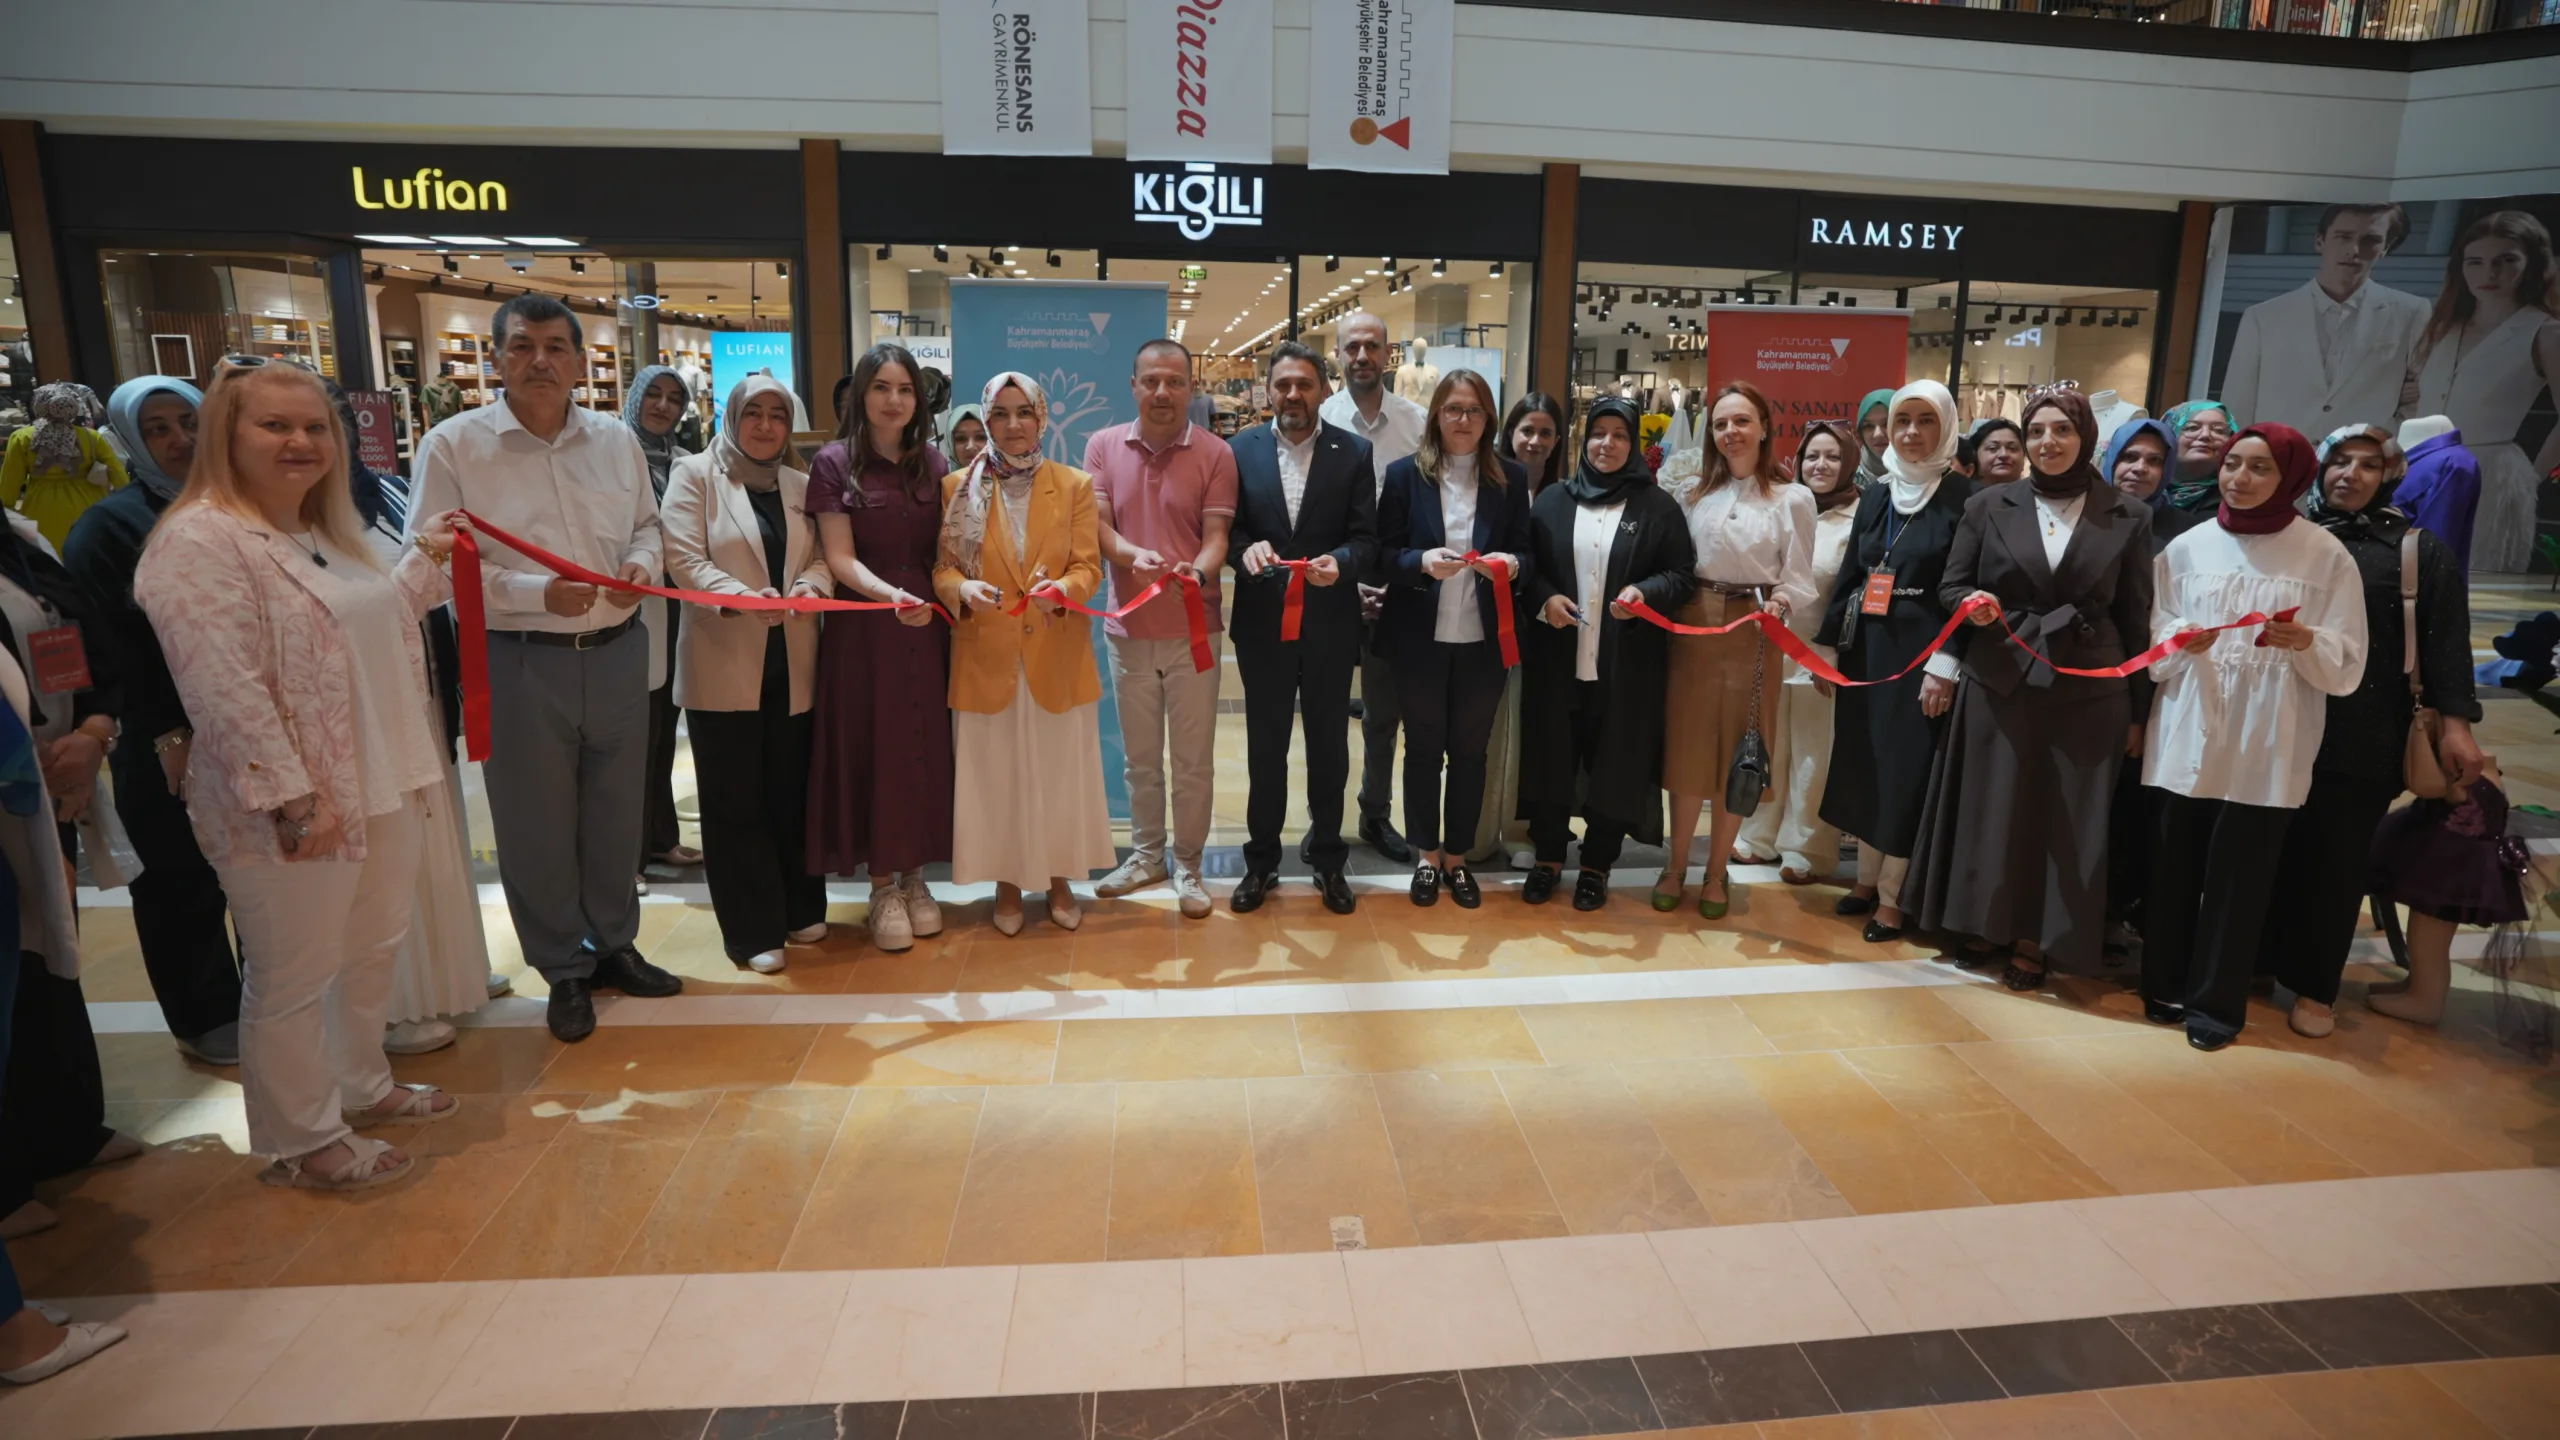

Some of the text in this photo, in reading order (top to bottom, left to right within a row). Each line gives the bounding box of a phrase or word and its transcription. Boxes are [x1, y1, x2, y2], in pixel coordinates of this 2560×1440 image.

[992, 13, 1011, 133] GAYRİMENKUL
[1013, 14, 1036, 133] RÖNESANS
[1354, 56, 1373, 116] Belediyesi
[352, 166, 507, 211] Lufian
[1811, 218, 1964, 251] RAMSEY
[1007, 326, 1090, 337] Kahramanmaraş
[726, 344, 785, 356] LUFIAN
[1757, 350, 1831, 361] Kahramanmaraş
[1757, 361, 1830, 372] Büyükşehir Belediyesi
[1792, 402, 1853, 417] SANAT
